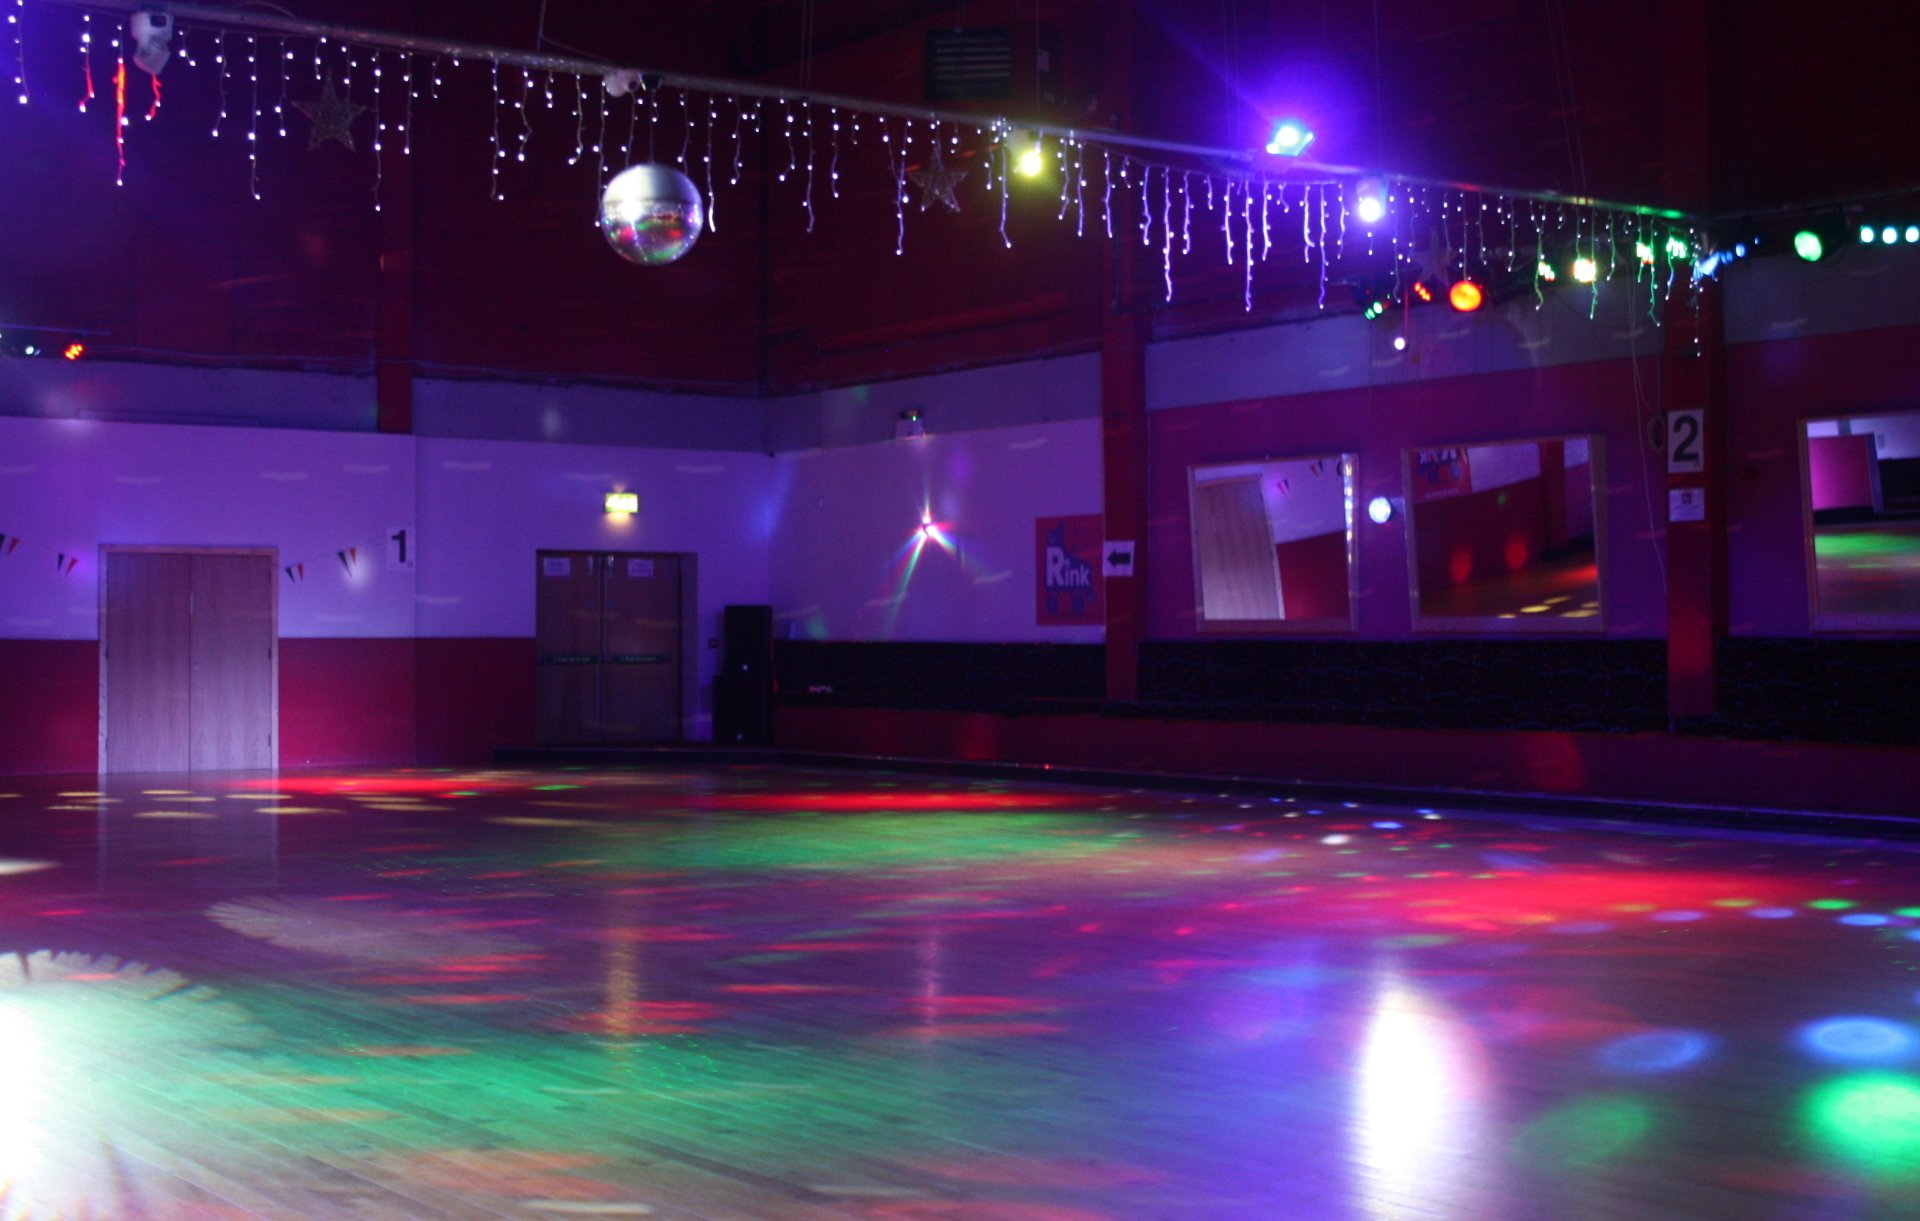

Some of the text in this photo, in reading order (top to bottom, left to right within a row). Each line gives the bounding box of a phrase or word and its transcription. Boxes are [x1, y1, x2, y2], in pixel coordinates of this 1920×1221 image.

[1673, 415, 1699, 462] 2
[392, 529, 406, 563] 1
[1046, 547, 1090, 587] Rink
